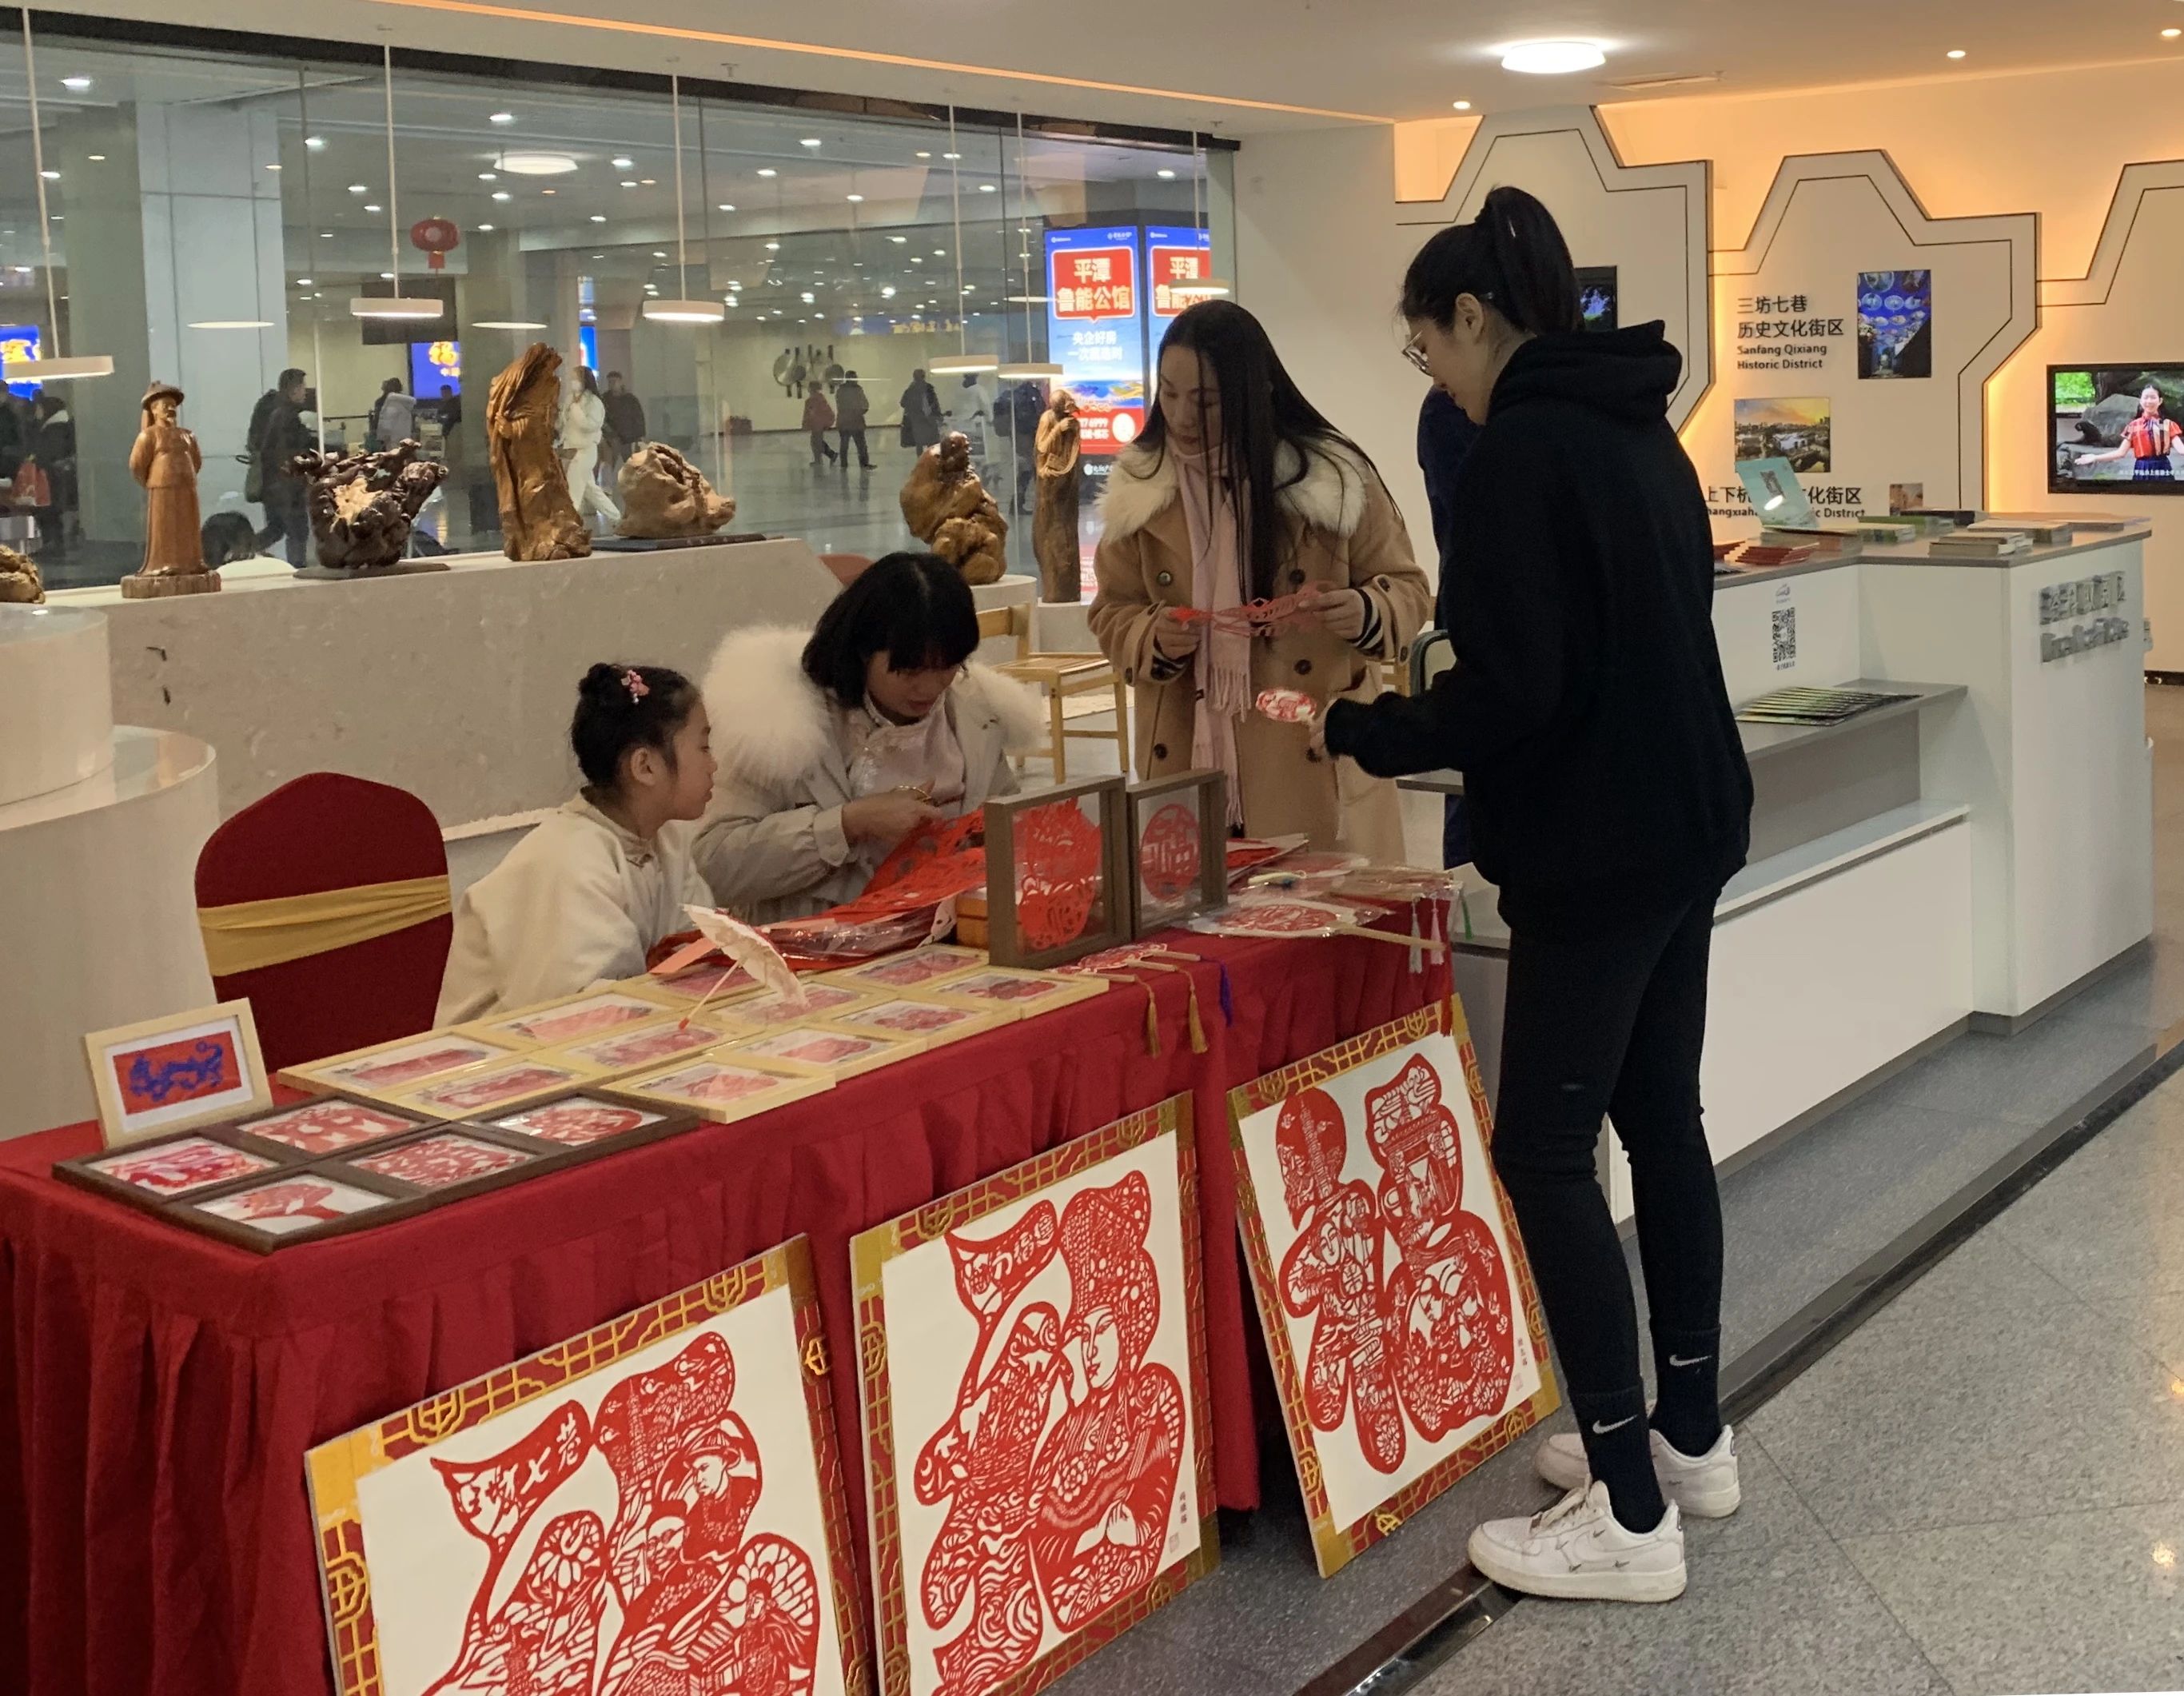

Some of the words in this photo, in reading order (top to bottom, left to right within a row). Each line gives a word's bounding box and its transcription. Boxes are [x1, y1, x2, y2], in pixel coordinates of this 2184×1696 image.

[1074, 257, 1112, 284] 平潭
[1056, 285, 1131, 313] 鲁能公馆
[1736, 294, 1807, 314] 三坊七巷
[1737, 318, 1844, 339] 历史文化街区
[1737, 345, 1781, 356] Sanfang
[1784, 344, 1827, 356] Qixiang
[1737, 360, 1779, 369] Historic
[1783, 359, 1823, 369] District
[1823, 507, 1865, 518] District
